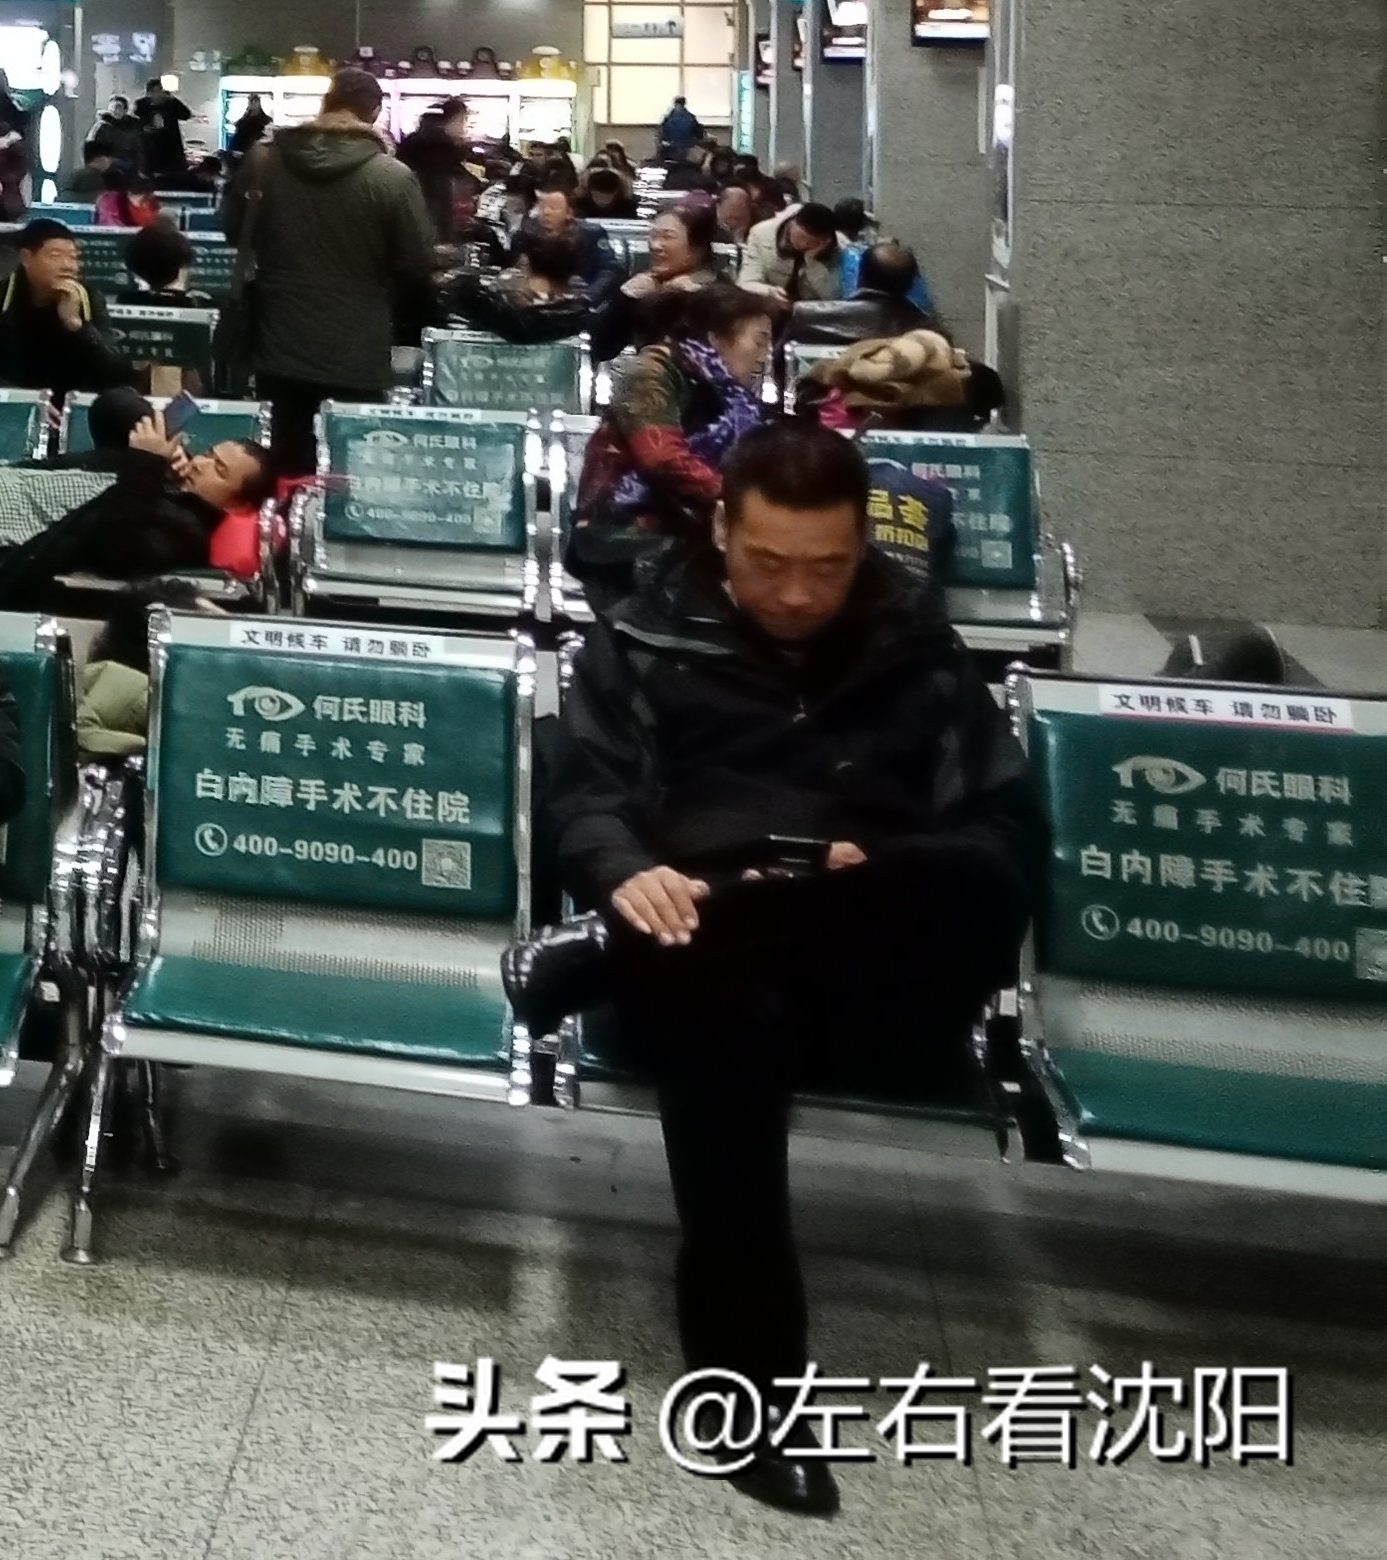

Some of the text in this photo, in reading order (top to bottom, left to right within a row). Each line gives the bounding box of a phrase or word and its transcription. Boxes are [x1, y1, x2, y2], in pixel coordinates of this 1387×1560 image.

[242, 629, 432, 659] 文明候车 请勿躺卧
[312, 693, 427, 729] 何氏眼科
[1113, 692, 1339, 725] 文明候车 请勿躺卧
[225, 726, 426, 767] 无痛手术专家
[195, 767, 471, 825] 白内障手术不住院
[1215, 766, 1353, 806] 何氏眼科
[1109, 799, 1354, 847] 无痛手术专家
[232, 833, 418, 872] 400-9090-400
[1126, 916, 1351, 963] 400-9090-400
